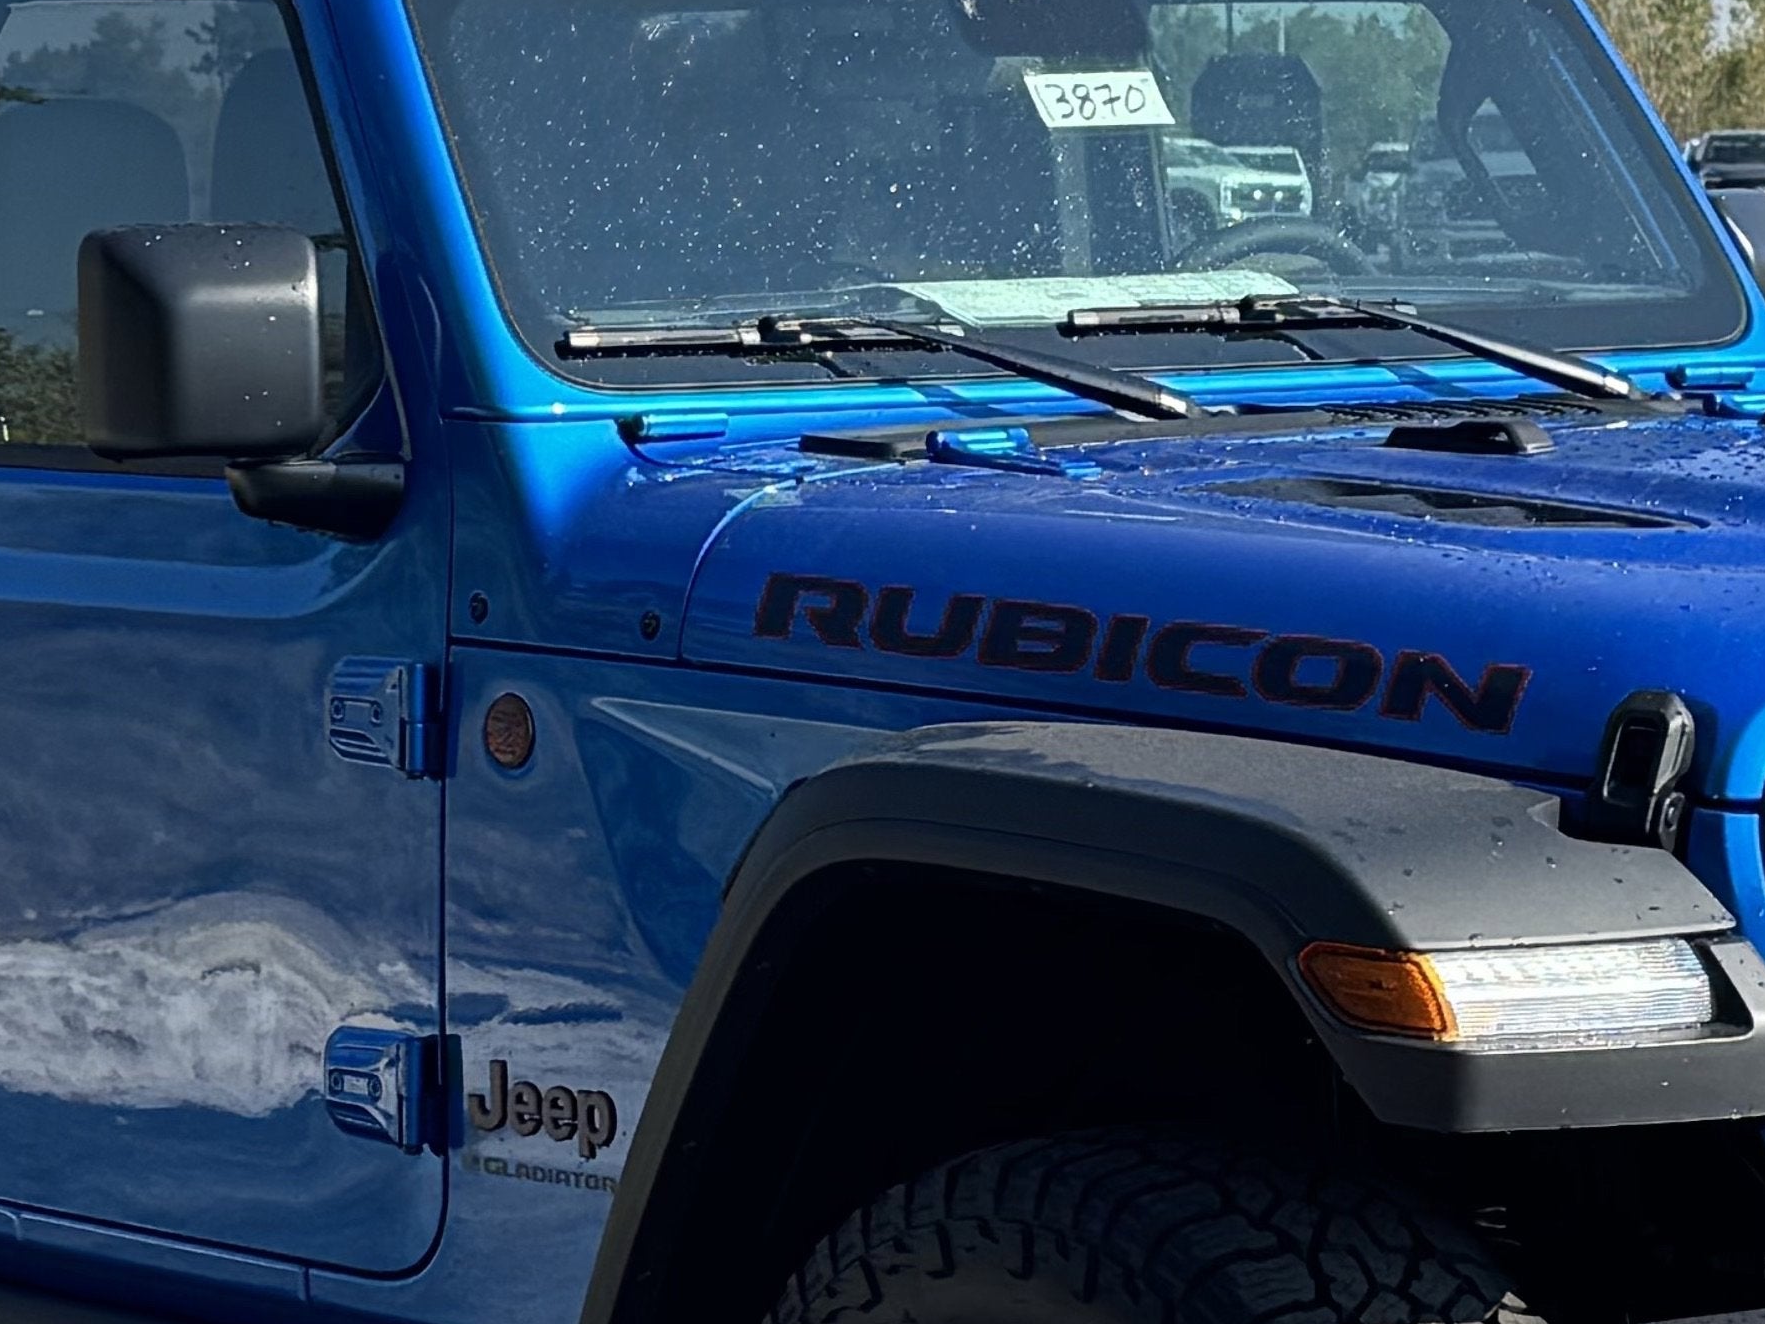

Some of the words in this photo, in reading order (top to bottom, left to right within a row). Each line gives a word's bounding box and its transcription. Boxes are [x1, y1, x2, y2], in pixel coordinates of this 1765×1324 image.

[752, 572, 1534, 736] RUBICON
[468, 1059, 617, 1159] Jeep
[483, 1156, 615, 1193] GLADIATOR
